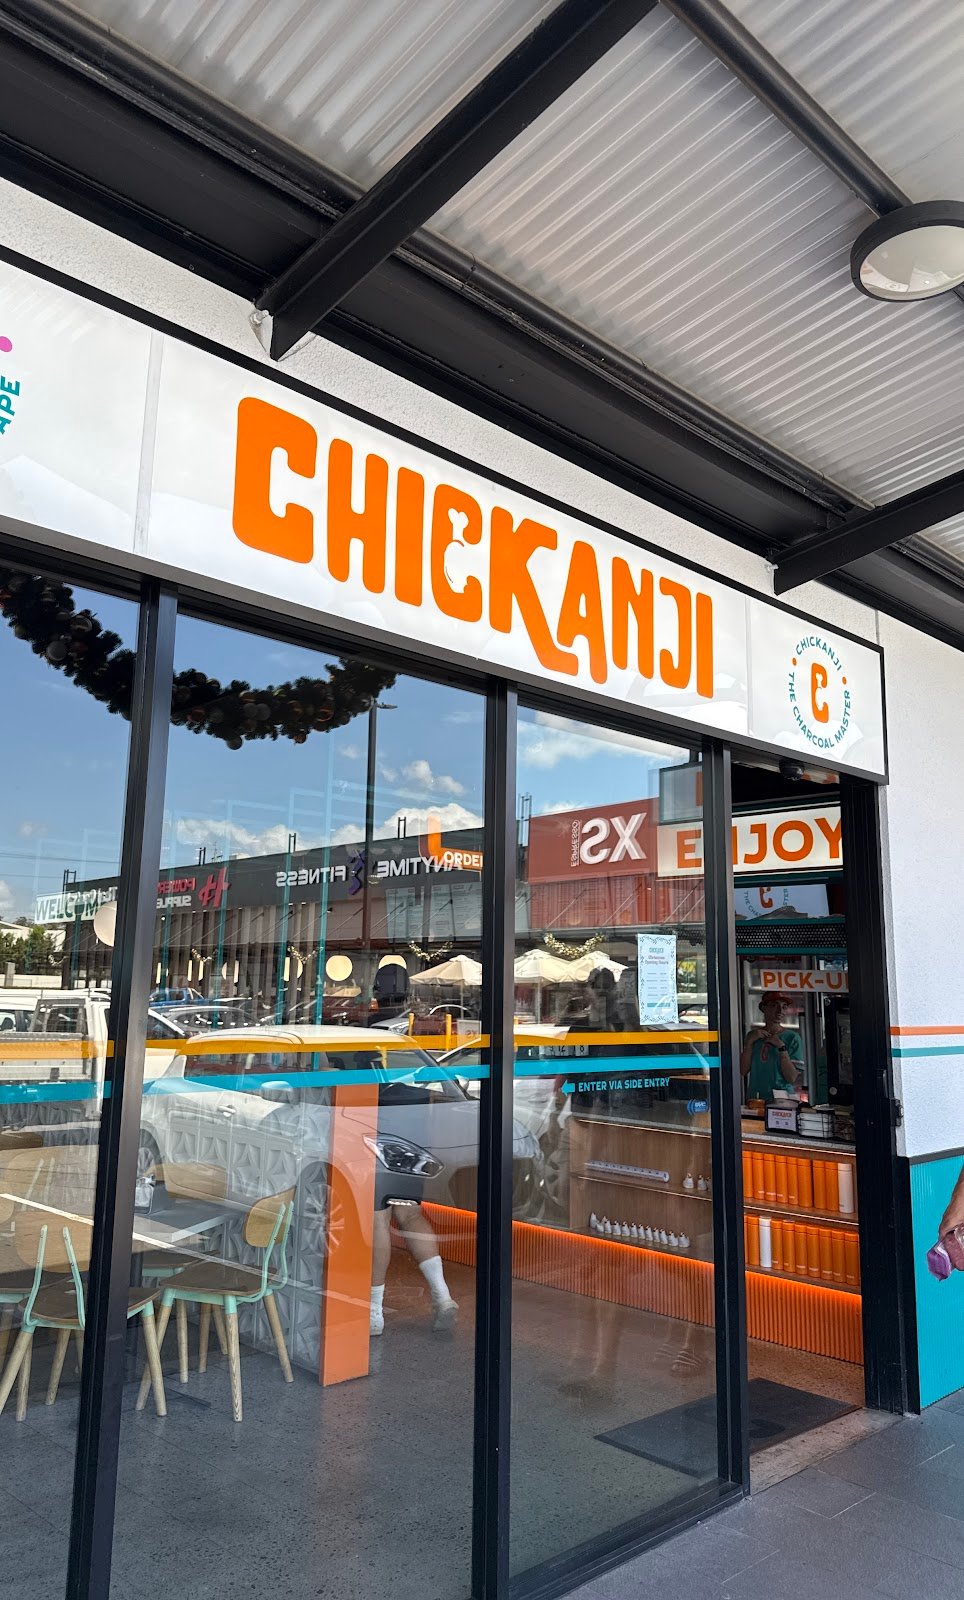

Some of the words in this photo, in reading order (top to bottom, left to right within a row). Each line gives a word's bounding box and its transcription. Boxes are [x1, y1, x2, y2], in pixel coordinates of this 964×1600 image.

[232, 396, 714, 699] CHICKANJI
[795, 636, 842, 671] CHICKANJI
[788, 672, 796, 703] THE
[793, 706, 835, 749] CHARCOAL
[834, 690, 851, 743] MASTER
[676, 817, 841, 869] EJOY
[762, 971, 848, 990] PICK-U
[578, 1081, 607, 1092] ENTER
[609, 1080, 622, 1090] VIA
[624, 1079, 642, 1088] SIDE
[644, 1077, 670, 1087] ENTRY
